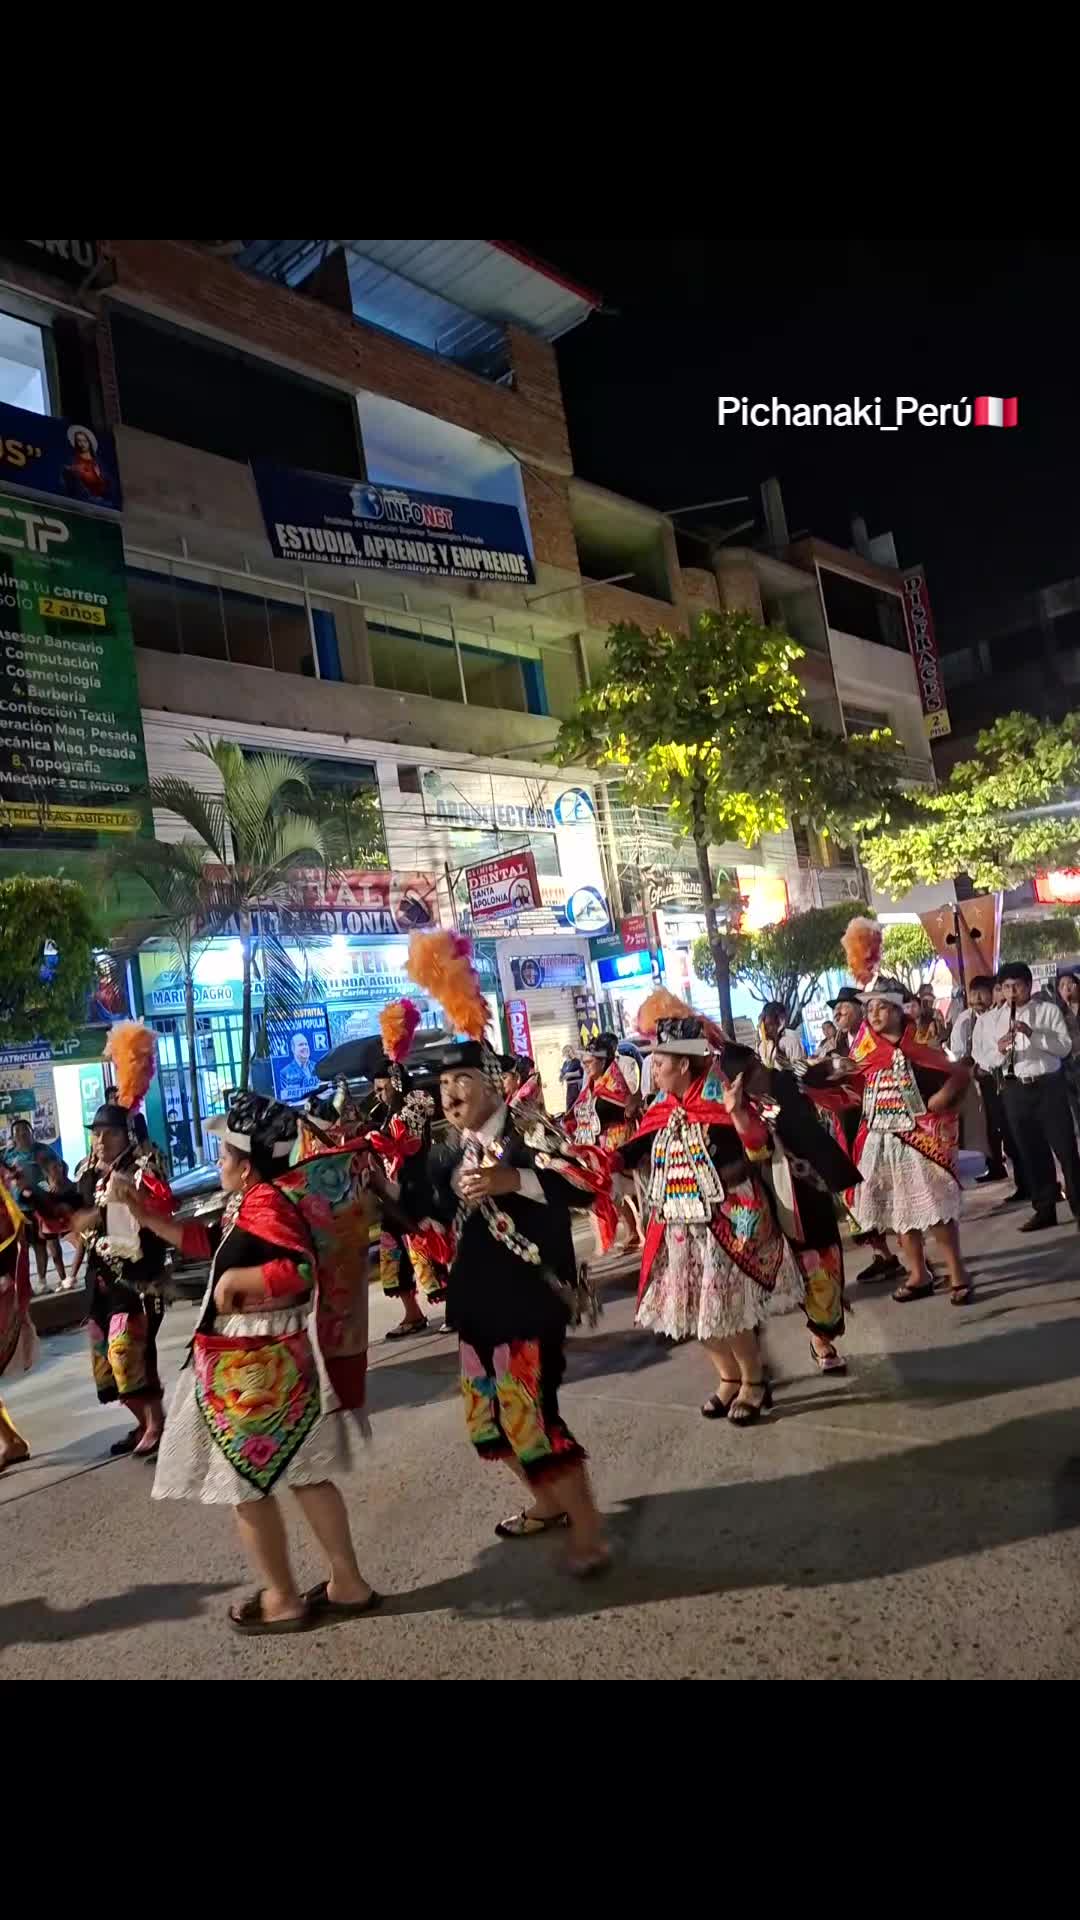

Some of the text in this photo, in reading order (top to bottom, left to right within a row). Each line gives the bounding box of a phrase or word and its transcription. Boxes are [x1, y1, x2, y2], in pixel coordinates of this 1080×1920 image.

[382, 496, 454, 531] INFONET
[274, 522, 529, 576] ESTUDIA, APRENDE Y EMPRENDE
[282, 548, 329, 563] Impulsa
[331, 556, 343, 564] tu
[441, 566, 450, 576] tu
[451, 566, 479, 579] futuro
[33, 578, 49, 594] tu
[53, 584, 109, 605] carrera
[44, 600, 54, 614] 2
[44, 634, 105, 656] Bancario
[5, 645, 99, 672] Computación
[79, 708, 116, 726] Textil
[91, 726, 138, 744] Pesada
[54, 740, 87, 758] Maq.
[89, 743, 137, 761] Pesada
[469, 863, 528, 888] DENTAL
[472, 887, 495, 900] SANTA
[473, 894, 509, 910] APOLONIA
[203, 988, 233, 1001] AGRO
[315, 1034, 327, 1049] R
